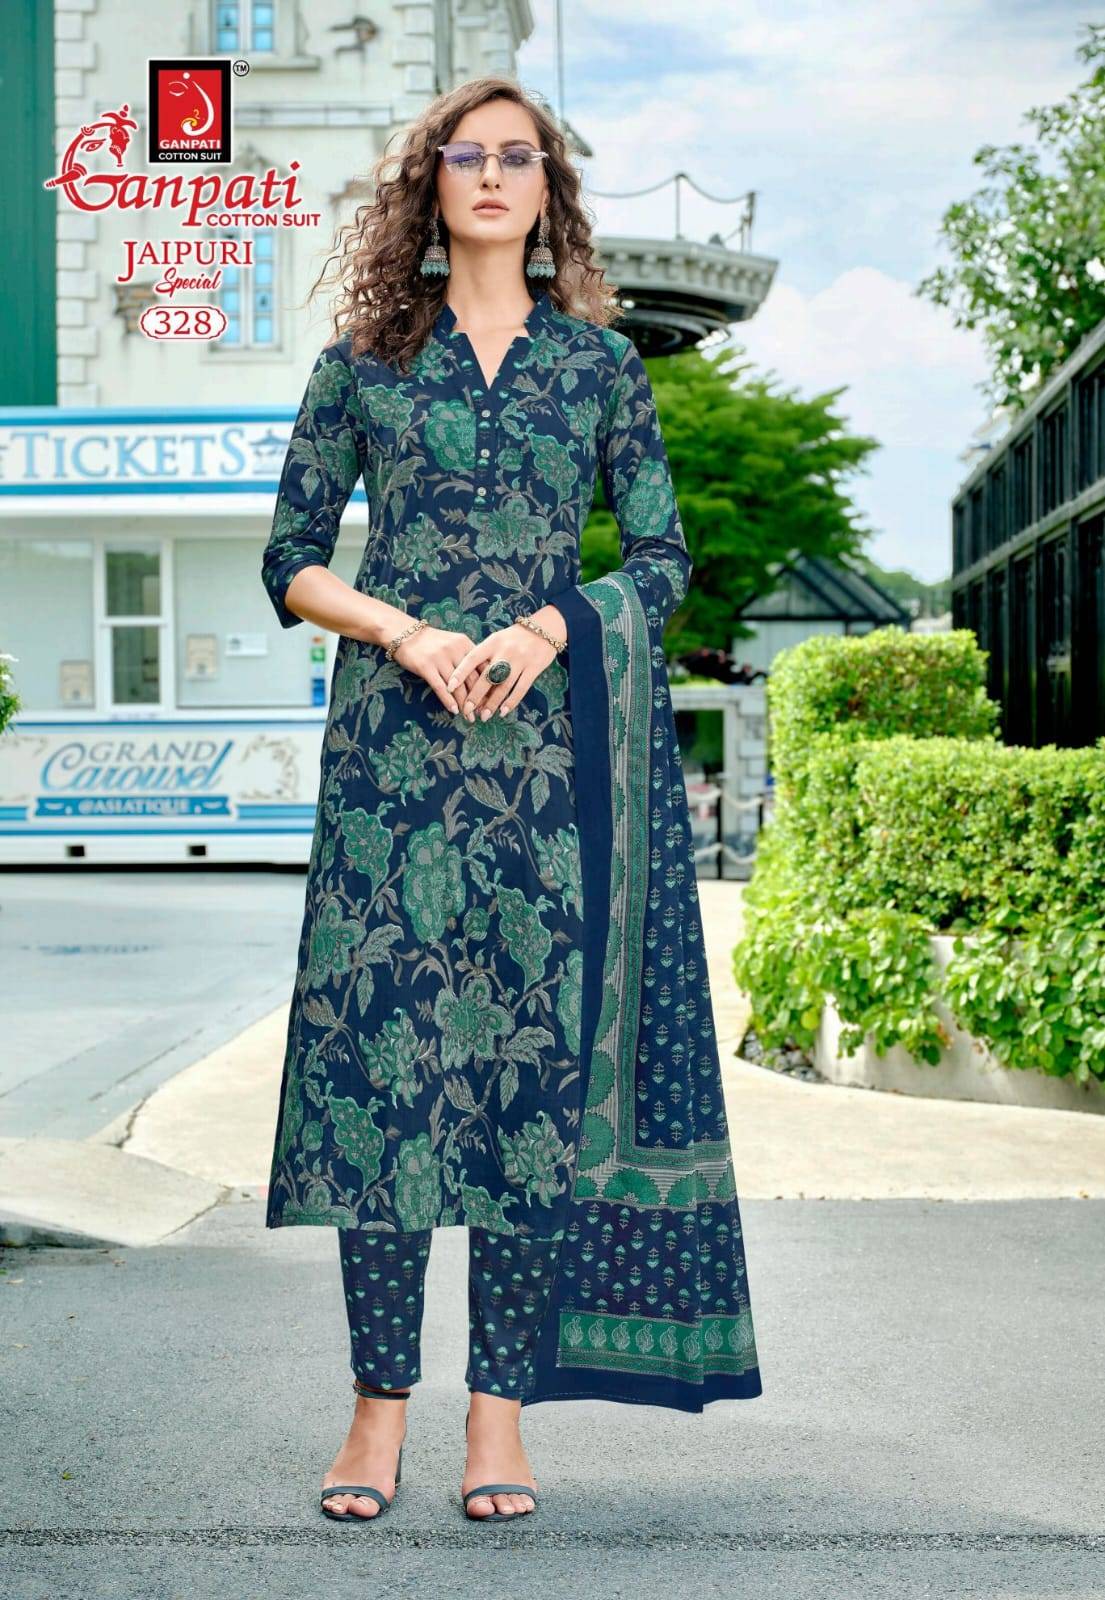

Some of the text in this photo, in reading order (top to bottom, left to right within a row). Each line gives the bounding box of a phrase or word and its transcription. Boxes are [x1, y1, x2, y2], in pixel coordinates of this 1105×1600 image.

[10, 427, 246, 479] TICKETS
[40, 740, 235, 792] Carousel
[89, 741, 217, 763] GRAND
